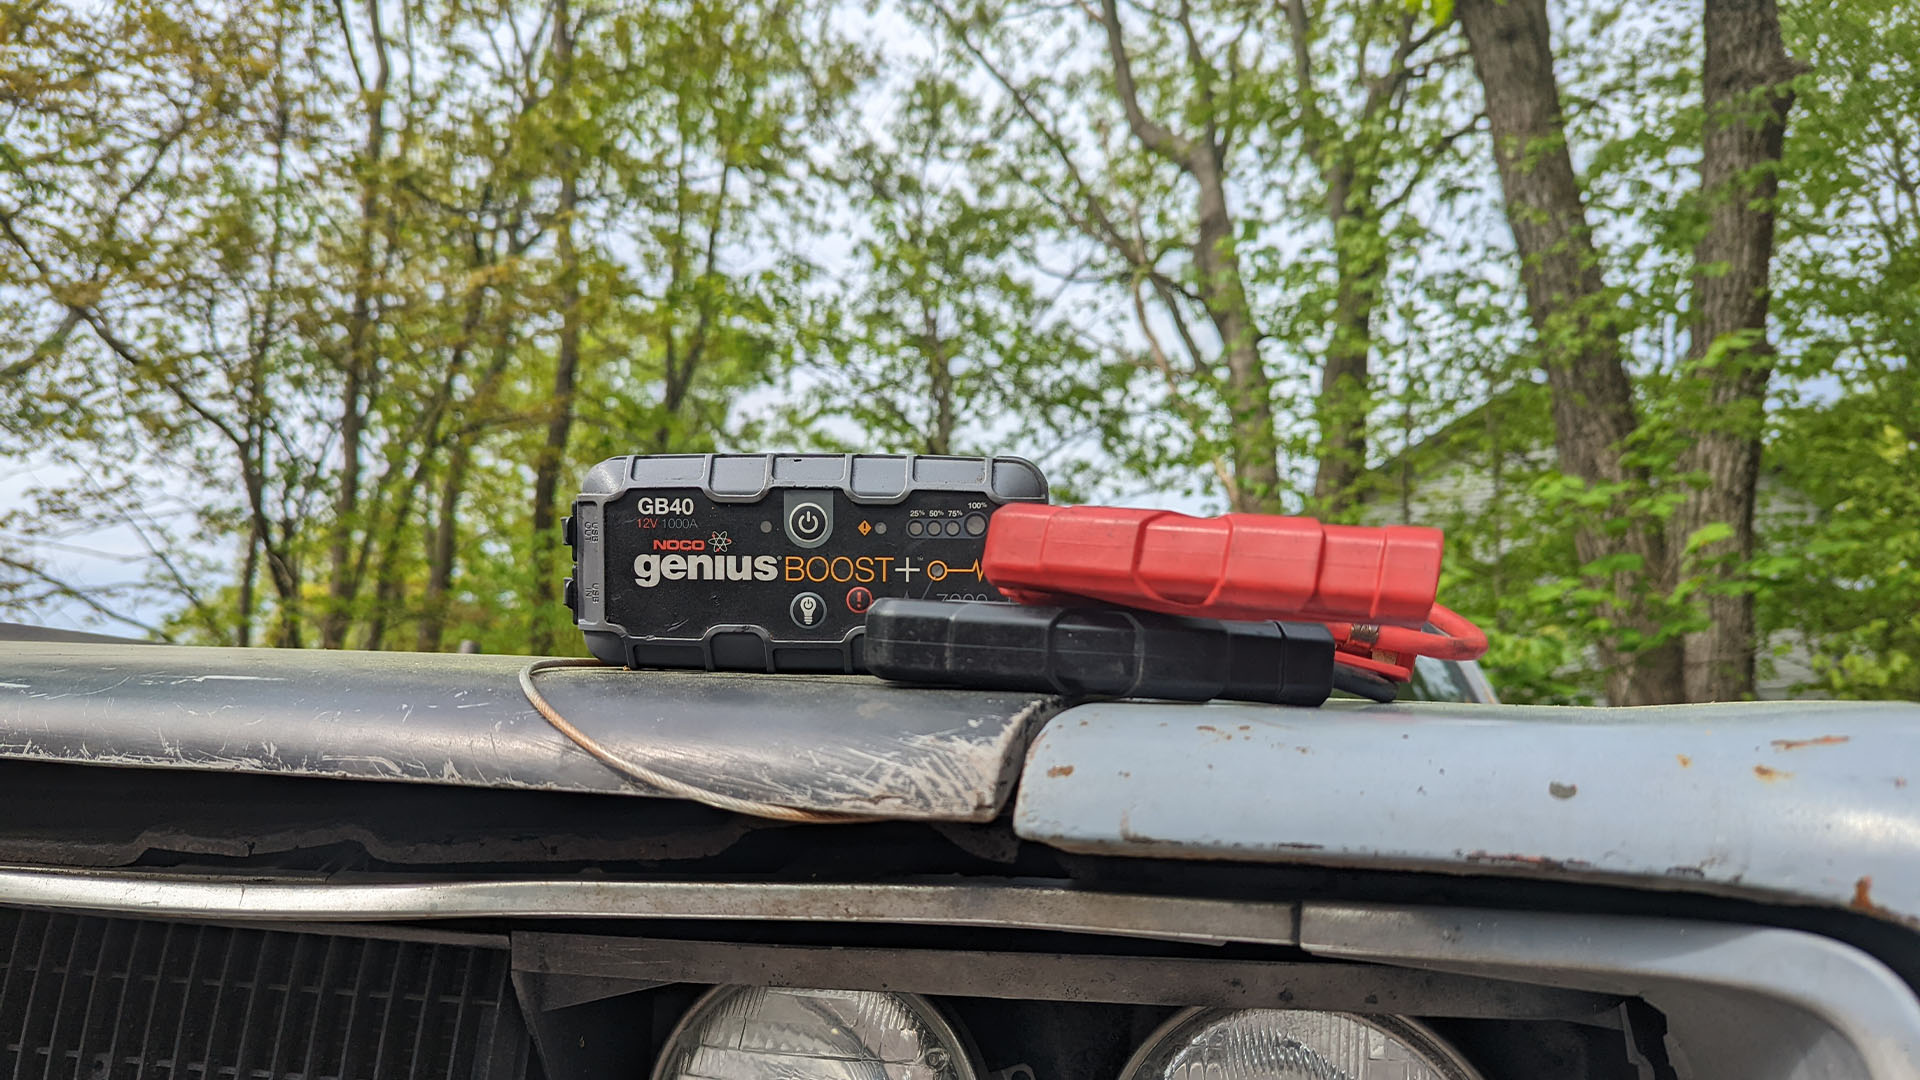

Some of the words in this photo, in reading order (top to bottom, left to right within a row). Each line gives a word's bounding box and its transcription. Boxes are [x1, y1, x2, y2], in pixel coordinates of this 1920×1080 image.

[637, 497, 695, 516] GB40
[909, 509, 926, 517] 25%
[928, 509, 945, 517] 50%
[947, 509, 963, 517] 75%
[967, 502, 988, 510] 100%
[637, 518, 658, 529] 12V
[663, 518, 699, 529] 1000A
[584, 521, 592, 542] OUT
[591, 522, 599, 543] USB
[653, 539, 706, 551] NOCO
[633, 553, 780, 588] genius
[585, 587, 593, 599] IN
[591, 583, 600, 603] USB
